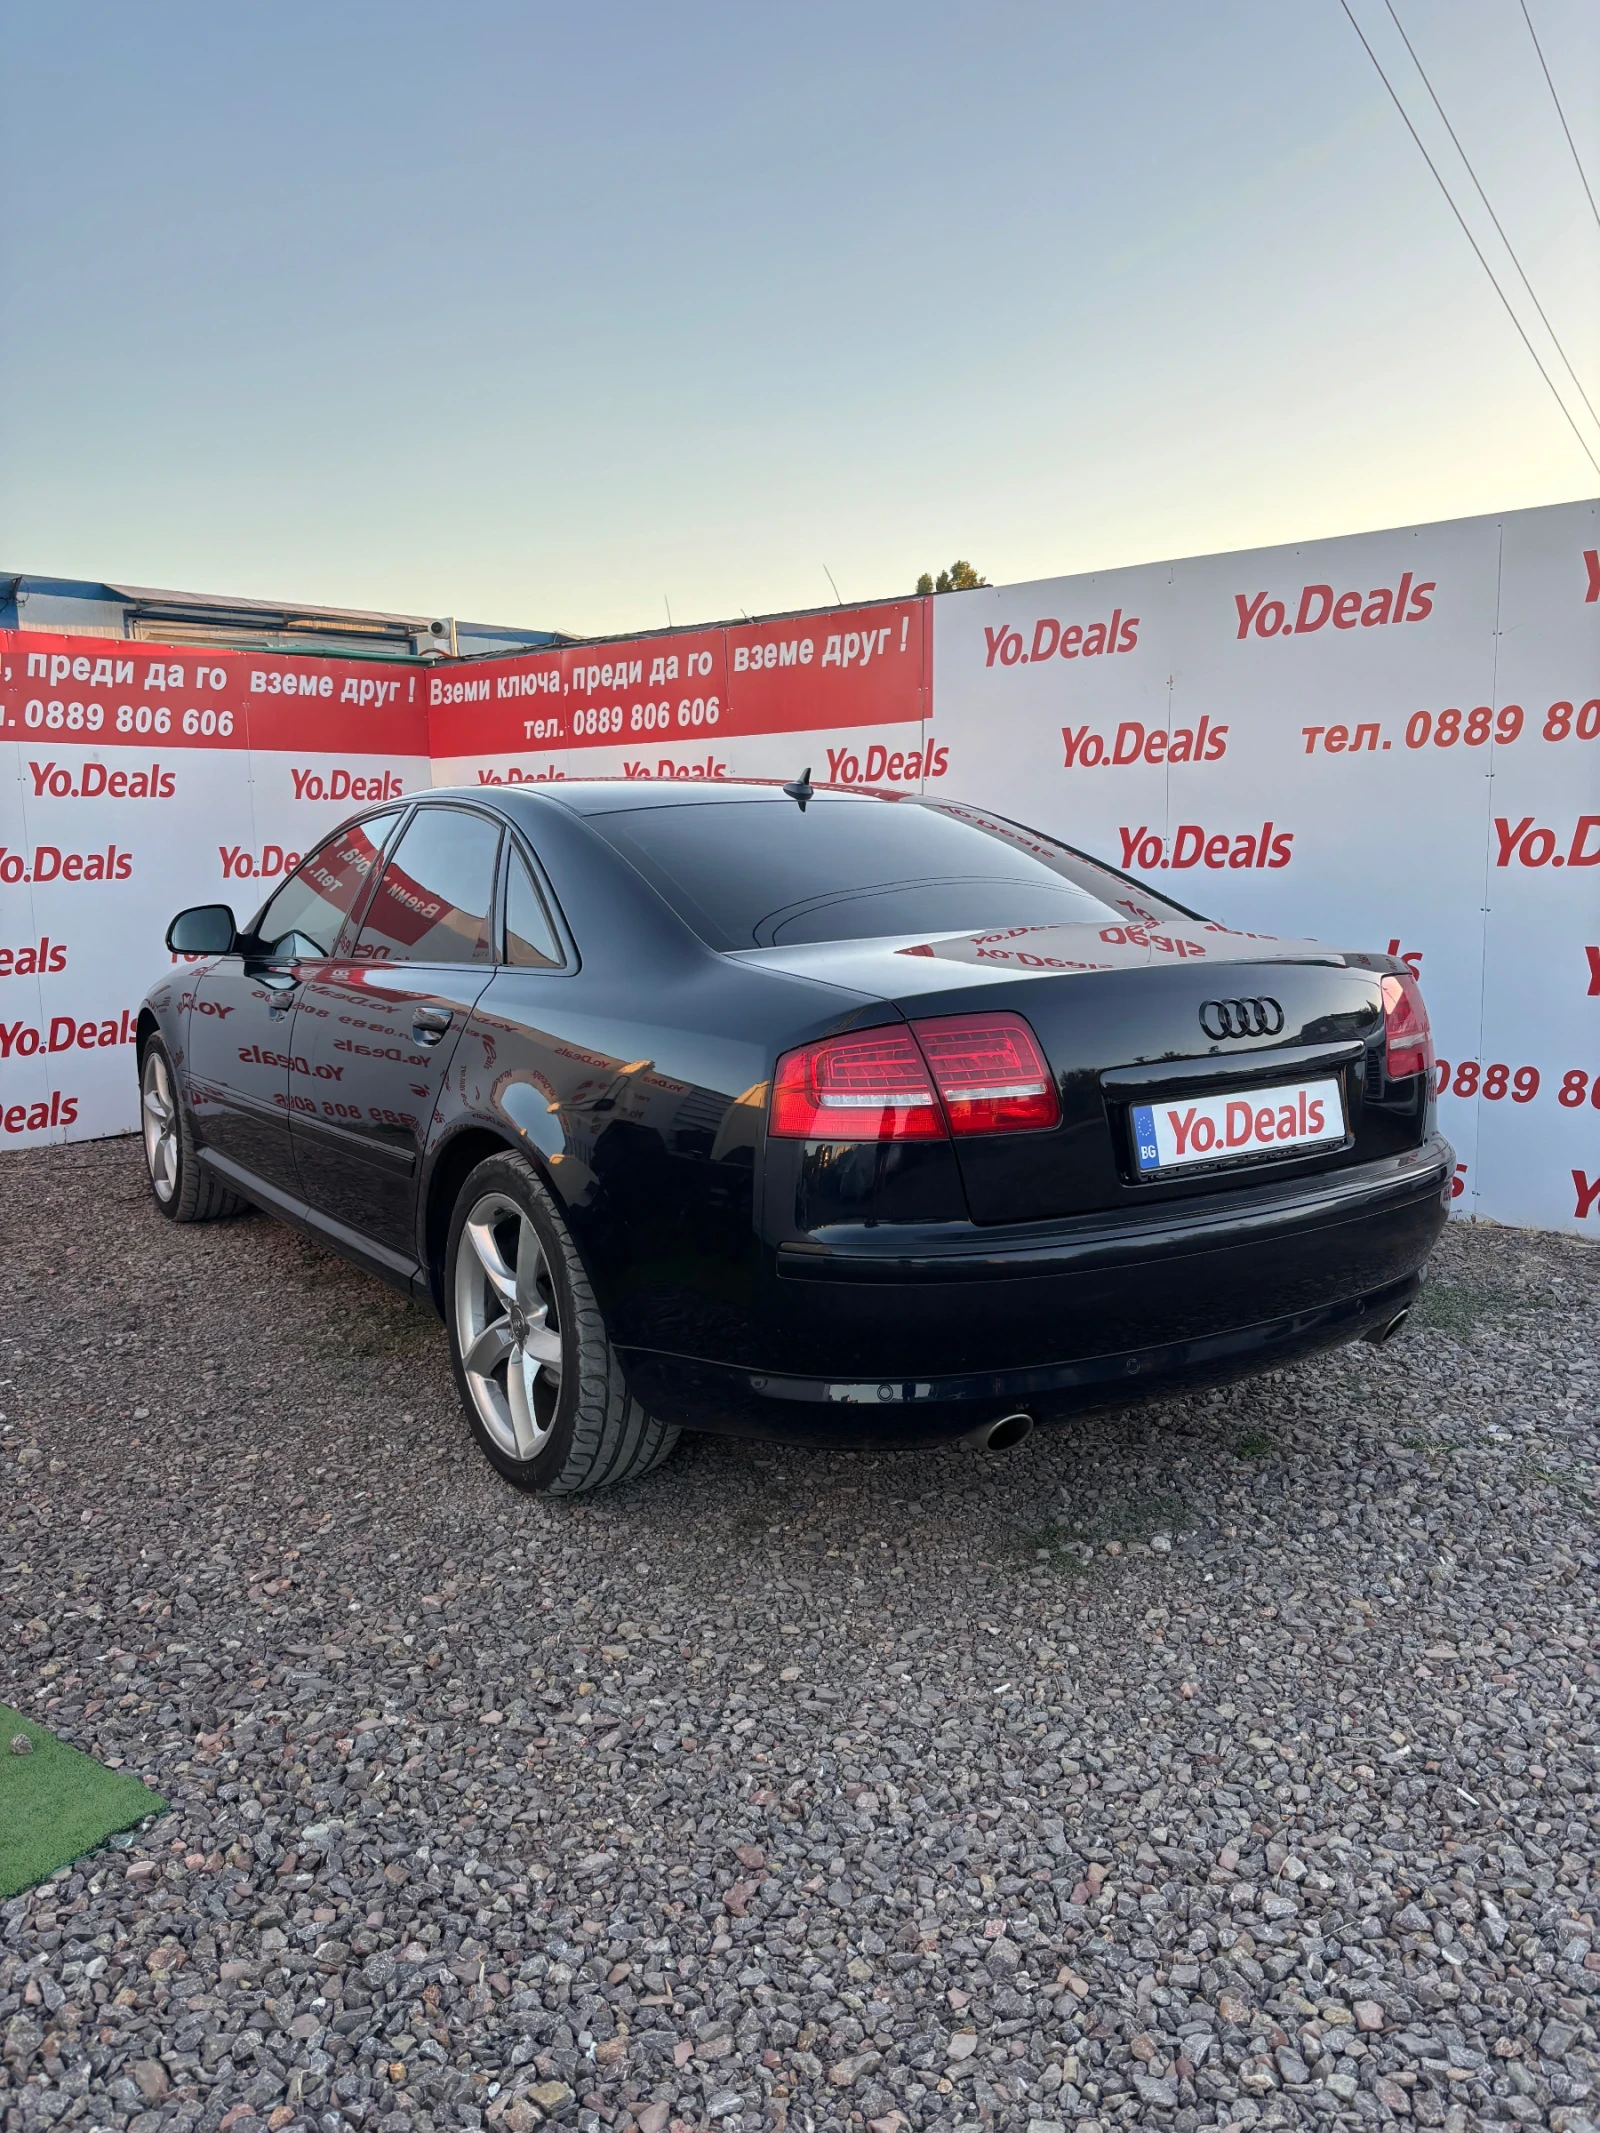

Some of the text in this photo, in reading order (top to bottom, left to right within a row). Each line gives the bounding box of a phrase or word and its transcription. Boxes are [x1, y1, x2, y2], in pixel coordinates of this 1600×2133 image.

[1235, 572, 1436, 639] Yo.Deals
[984, 609, 1139, 667] Yo.Deals
[27, 652, 134, 688] преди
[144, 662, 185, 692] да
[196, 666, 227, 690] го
[250, 670, 334, 697] вземе
[340, 677, 401, 707] друг
[430, 678, 490, 706] Вземи
[649, 655, 679, 686] да
[687, 651, 713, 676] го
[734, 638, 814, 671] вземе
[822, 627, 891, 667] друг
[24, 699, 105, 731] 0889
[116, 705, 171, 734] 806
[182, 708, 234, 736] 606
[524, 697, 719, 739] тел. 0889 806 606
[1062, 716, 1228, 767] Yo.Deals
[1302, 723, 1392, 754] тел.
[1405, 705, 1524, 749] 0889
[29, 762, 176, 798] Yo.Deals
[827, 738, 949, 783] Yo.Deals
[291, 769, 403, 801] Yo.Deals
[1119, 822, 1294, 870] Yo.Deals
[1167, 1090, 1325, 1155] Yo.Deals
[1140, 1145, 1156, 1160] BG
